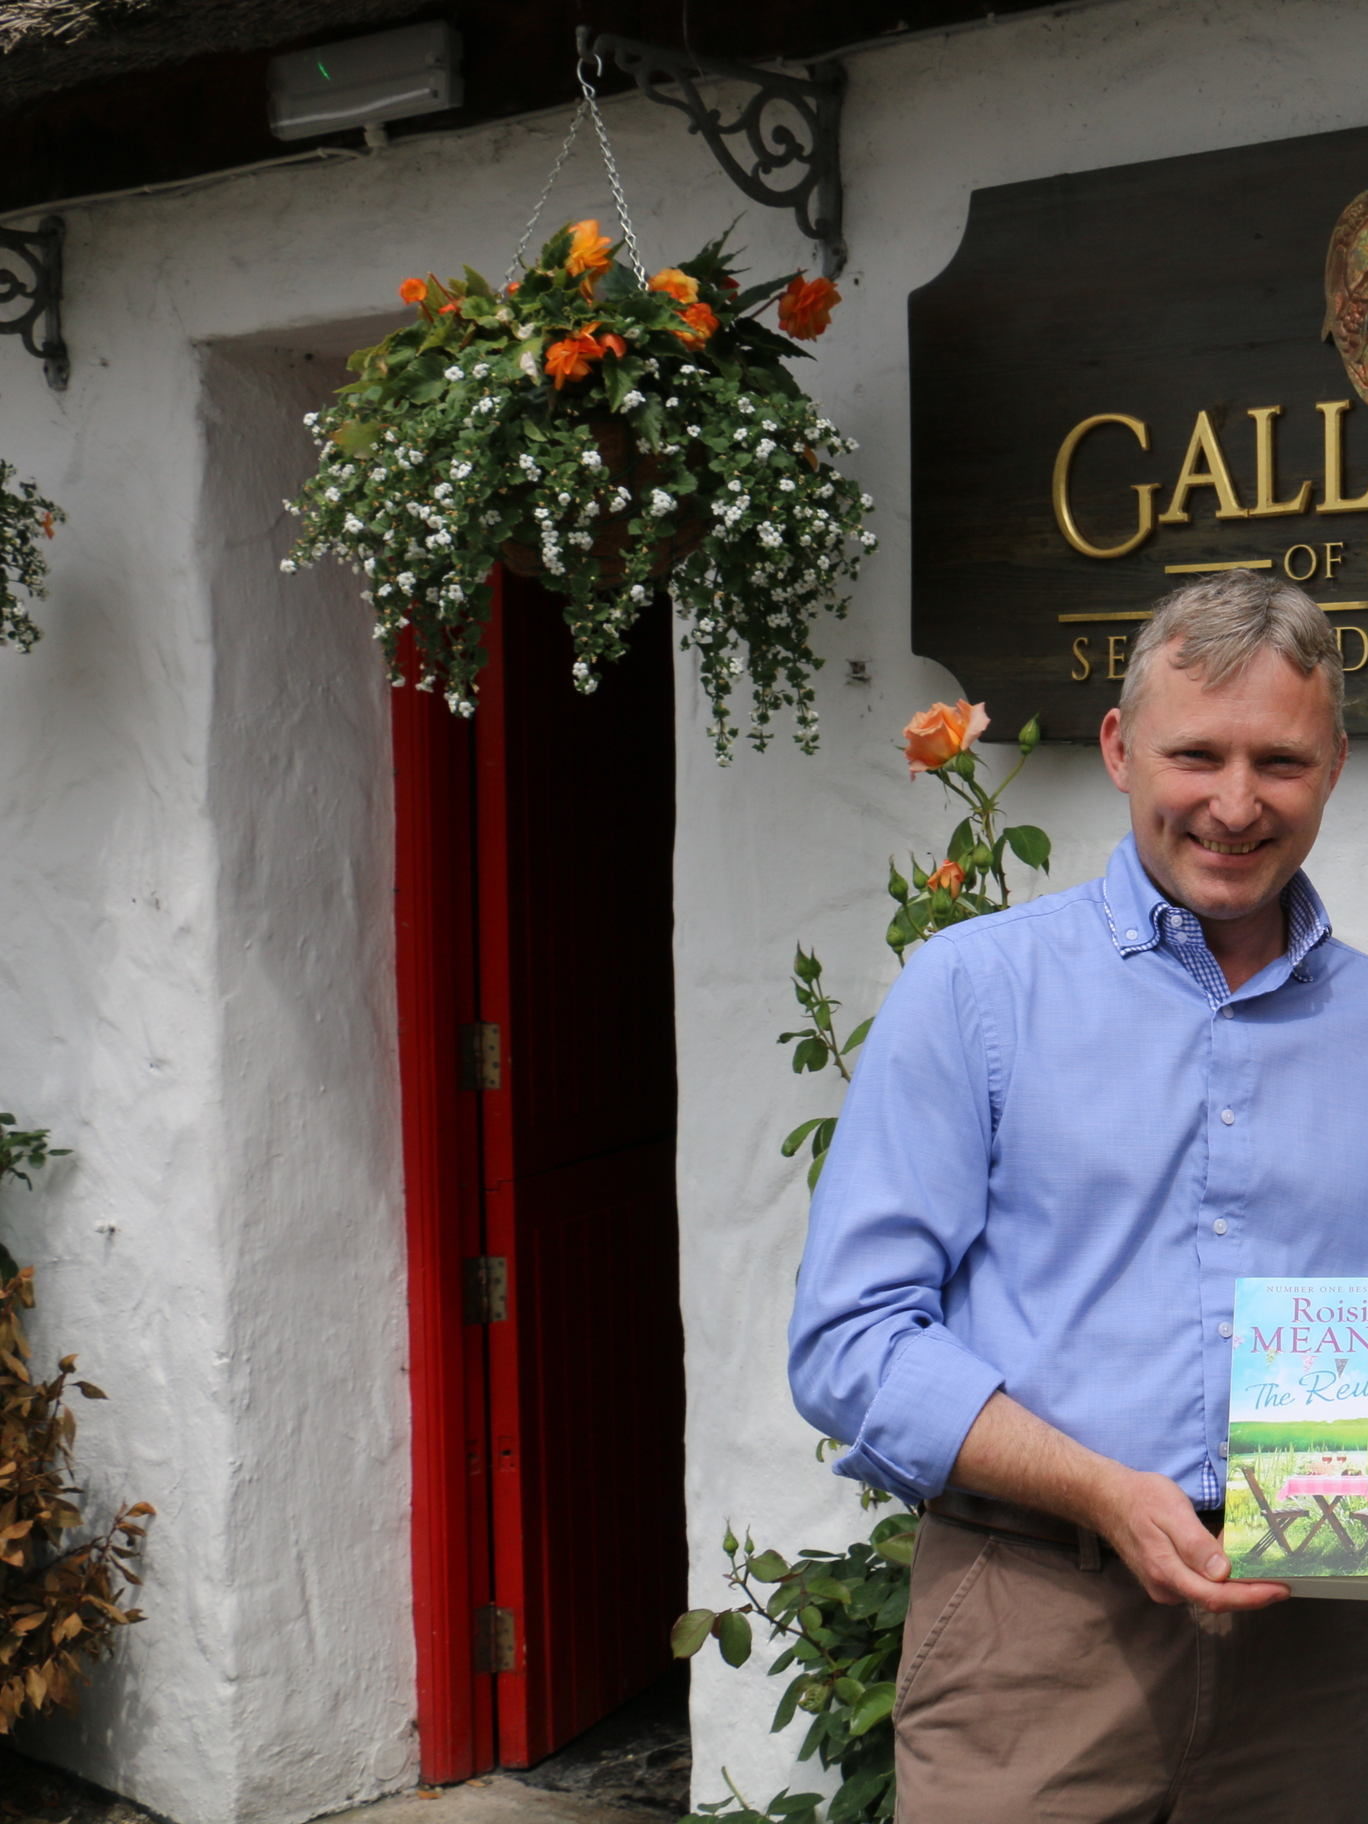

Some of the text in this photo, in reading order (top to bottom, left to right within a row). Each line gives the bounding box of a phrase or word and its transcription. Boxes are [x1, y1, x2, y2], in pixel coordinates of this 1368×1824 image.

[1283, 541, 1344, 581] OF
[1266, 1285, 1314, 1293] NUMBER
[1319, 1285, 1345, 1293] ONE
[1245, 1383, 1296, 1411] The
